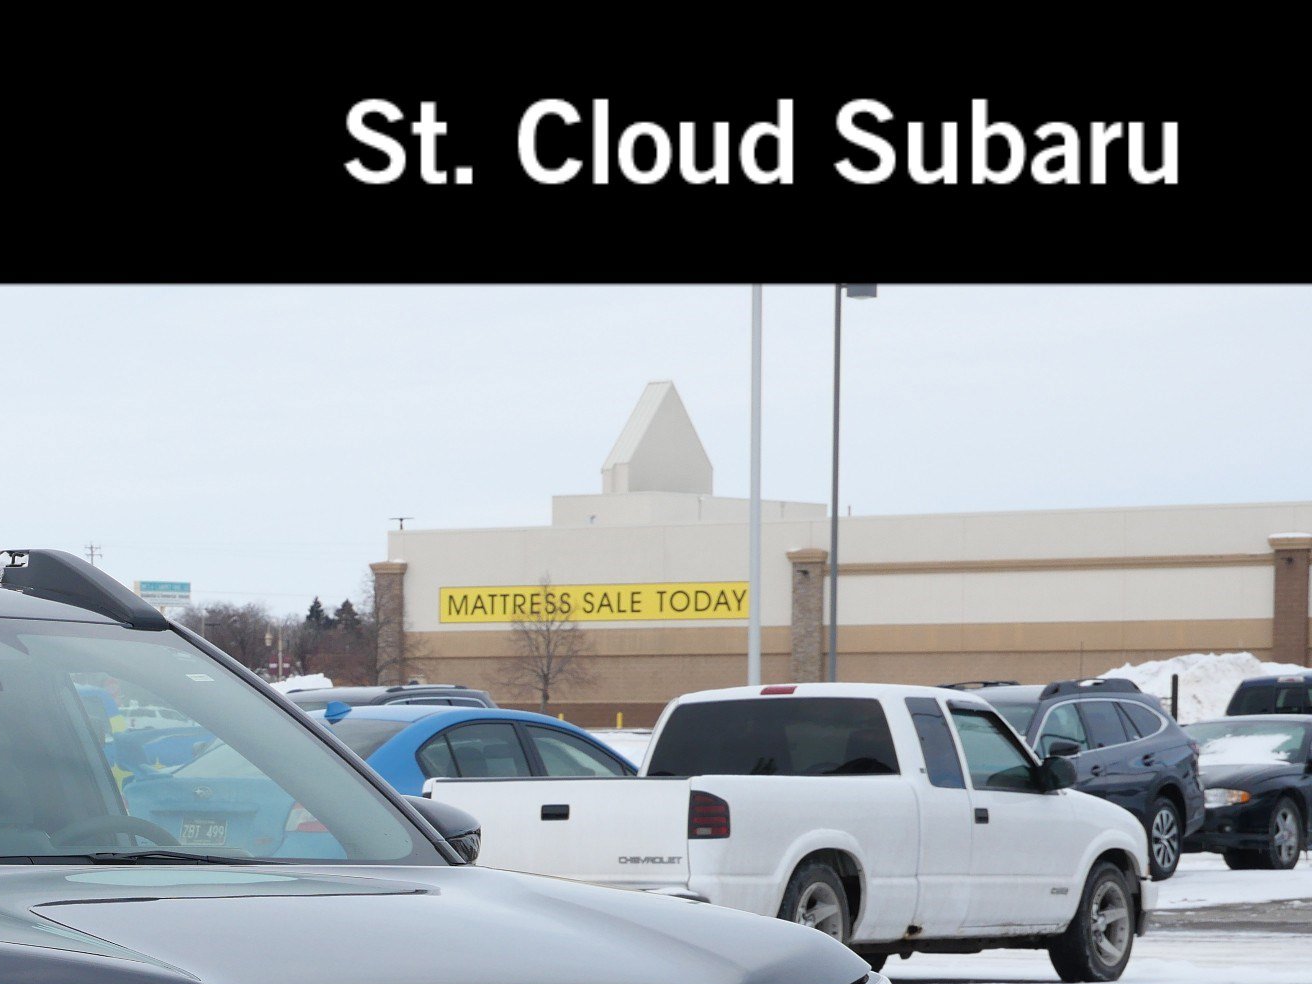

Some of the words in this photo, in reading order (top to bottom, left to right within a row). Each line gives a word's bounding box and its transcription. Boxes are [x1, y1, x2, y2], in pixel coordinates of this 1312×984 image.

[448, 592, 572, 616] MATTRESS
[582, 591, 642, 614] SALE
[656, 589, 748, 613] TODAY
[618, 856, 683, 865] CHEVROLET
